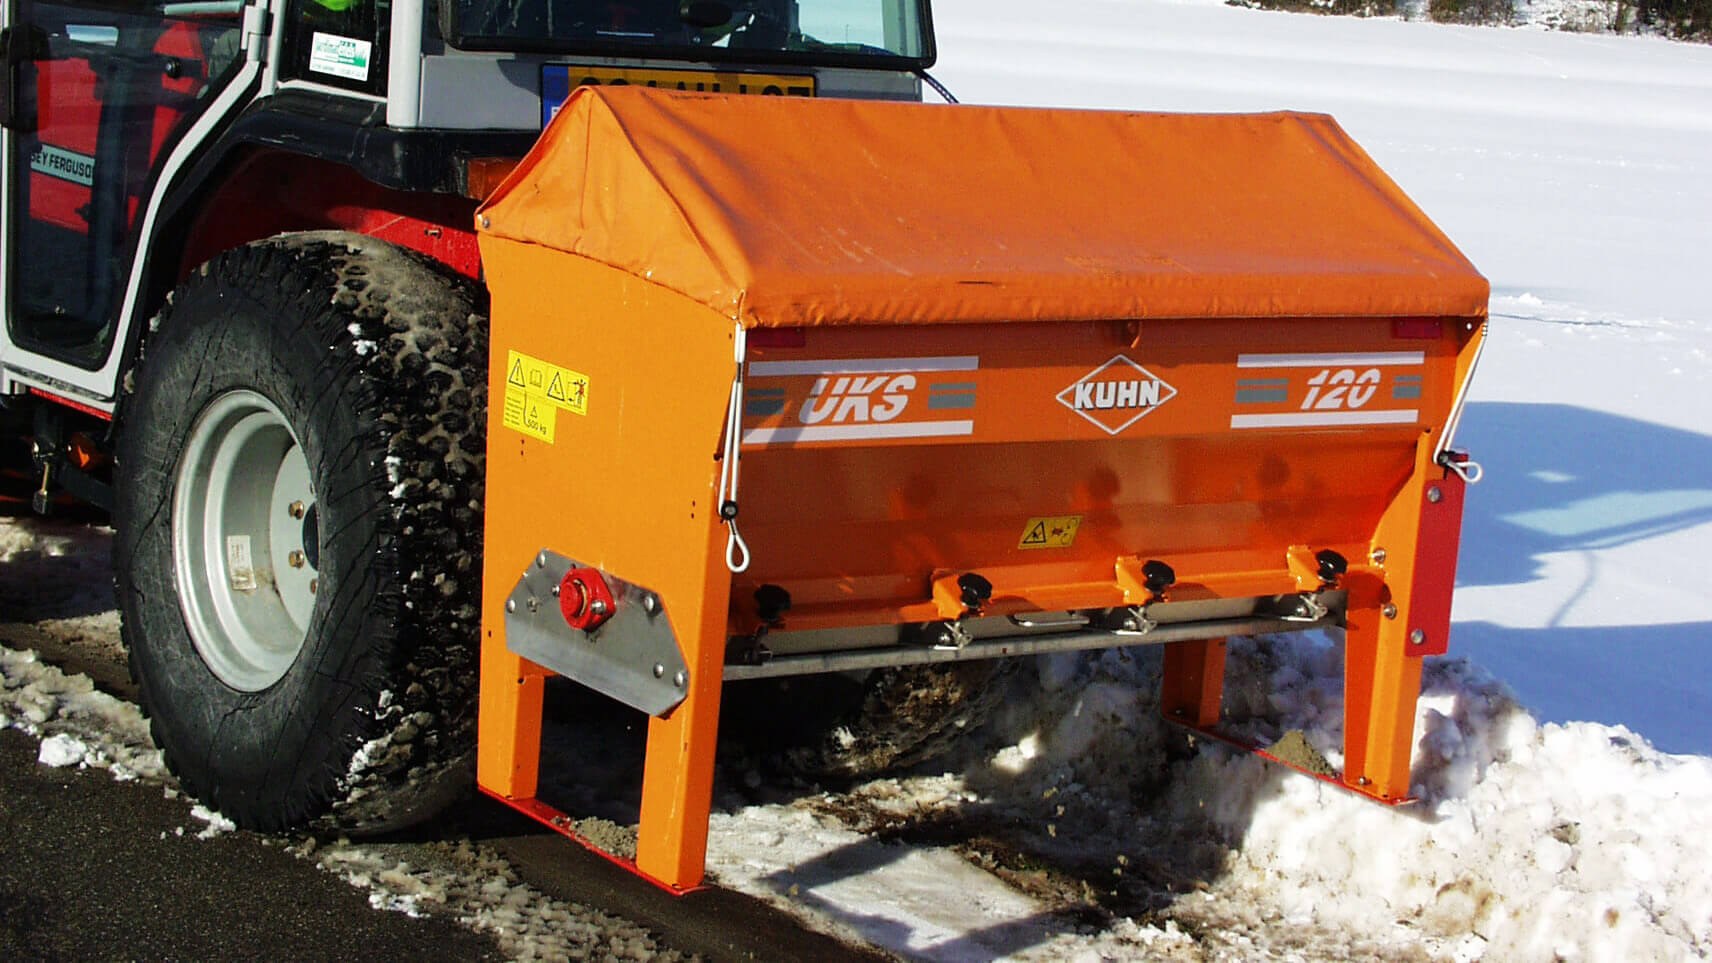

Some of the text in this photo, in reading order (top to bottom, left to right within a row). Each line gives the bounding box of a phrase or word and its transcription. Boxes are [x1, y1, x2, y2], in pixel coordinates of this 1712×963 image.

[799, 375, 917, 424] UKS
[1074, 380, 1160, 410] KUHN
[1300, 368, 1381, 410] 120
